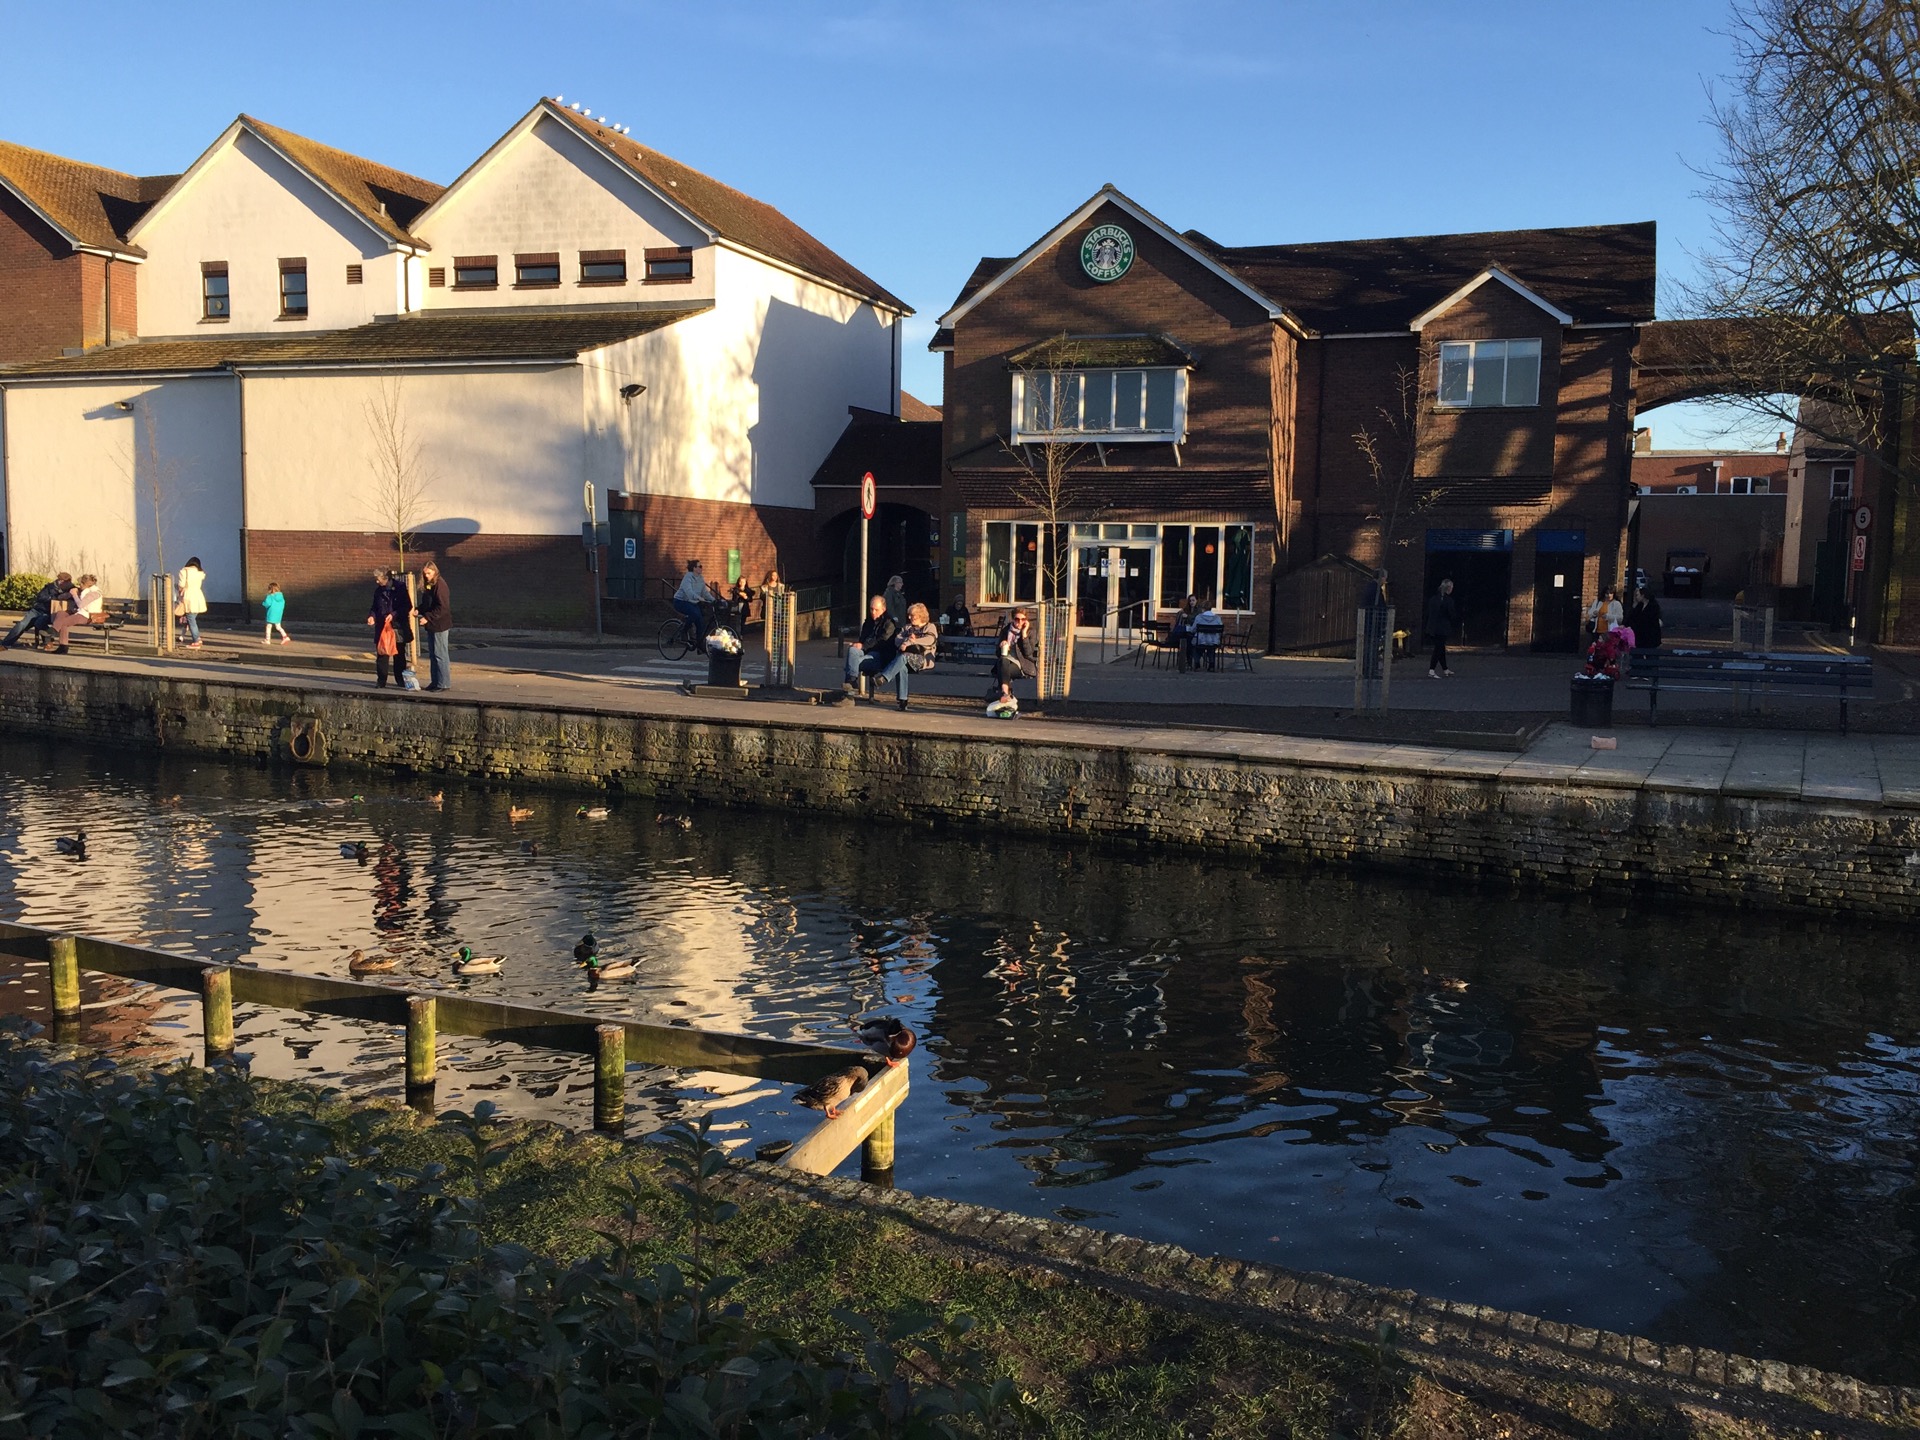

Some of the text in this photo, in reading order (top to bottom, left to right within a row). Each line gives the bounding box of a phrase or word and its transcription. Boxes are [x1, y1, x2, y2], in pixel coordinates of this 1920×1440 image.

[1085, 228, 1131, 254] STARBUCKS
[1086, 262, 1123, 278] COFFEE
[1860, 512, 1866, 523] 5
[953, 556, 966, 577] B
